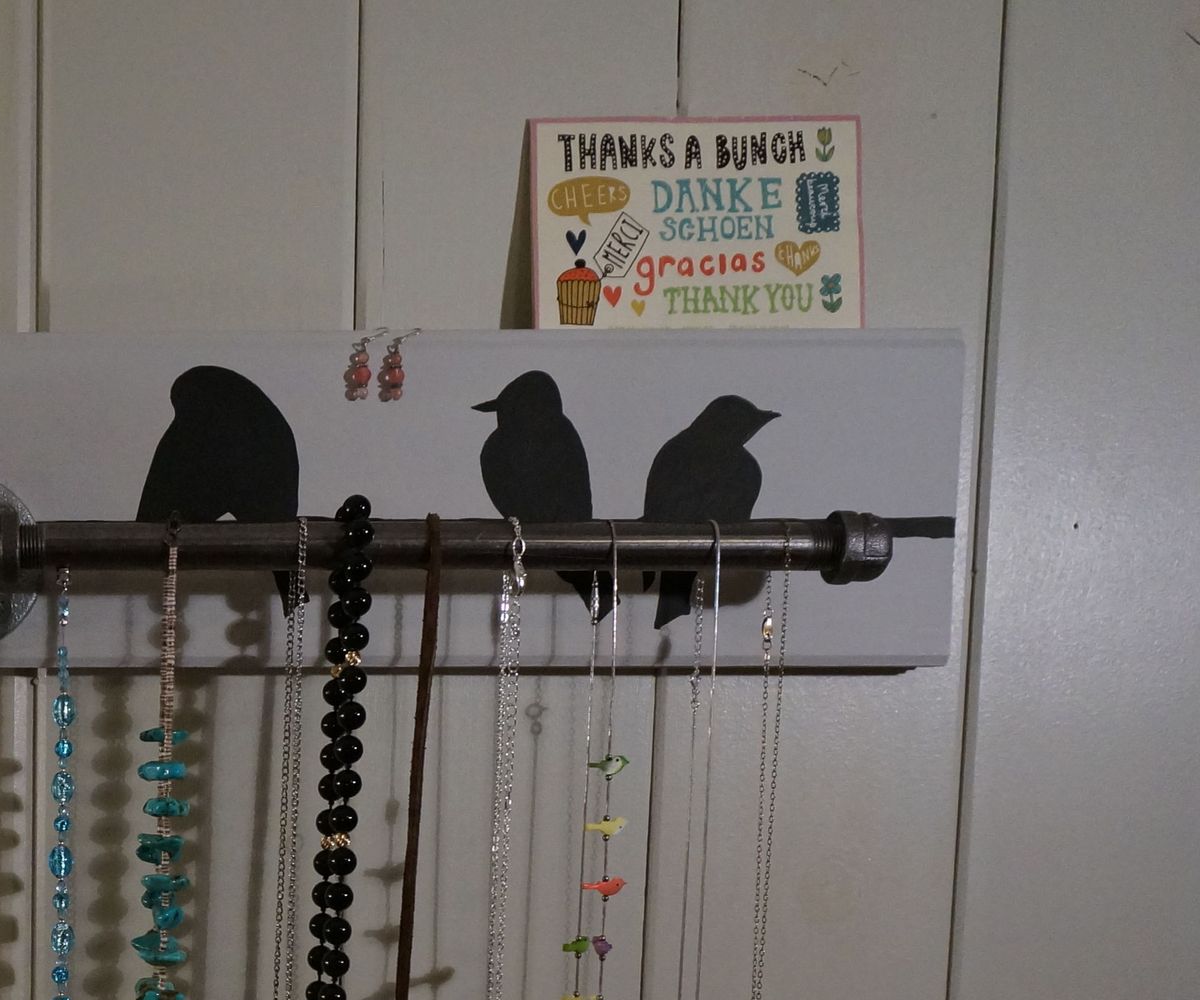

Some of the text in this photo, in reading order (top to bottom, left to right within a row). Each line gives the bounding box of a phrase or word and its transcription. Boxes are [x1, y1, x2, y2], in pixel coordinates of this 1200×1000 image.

[558, 131, 806, 171] THANKS A BUNCH
[551, 184, 627, 210] CHEERS
[651, 177, 782, 213] DANKE
[602, 219, 643, 269] MERCI
[659, 215, 774, 241] SCHOEN
[634, 250, 765, 296] gracias
[663, 283, 813, 314] THANK YOU
